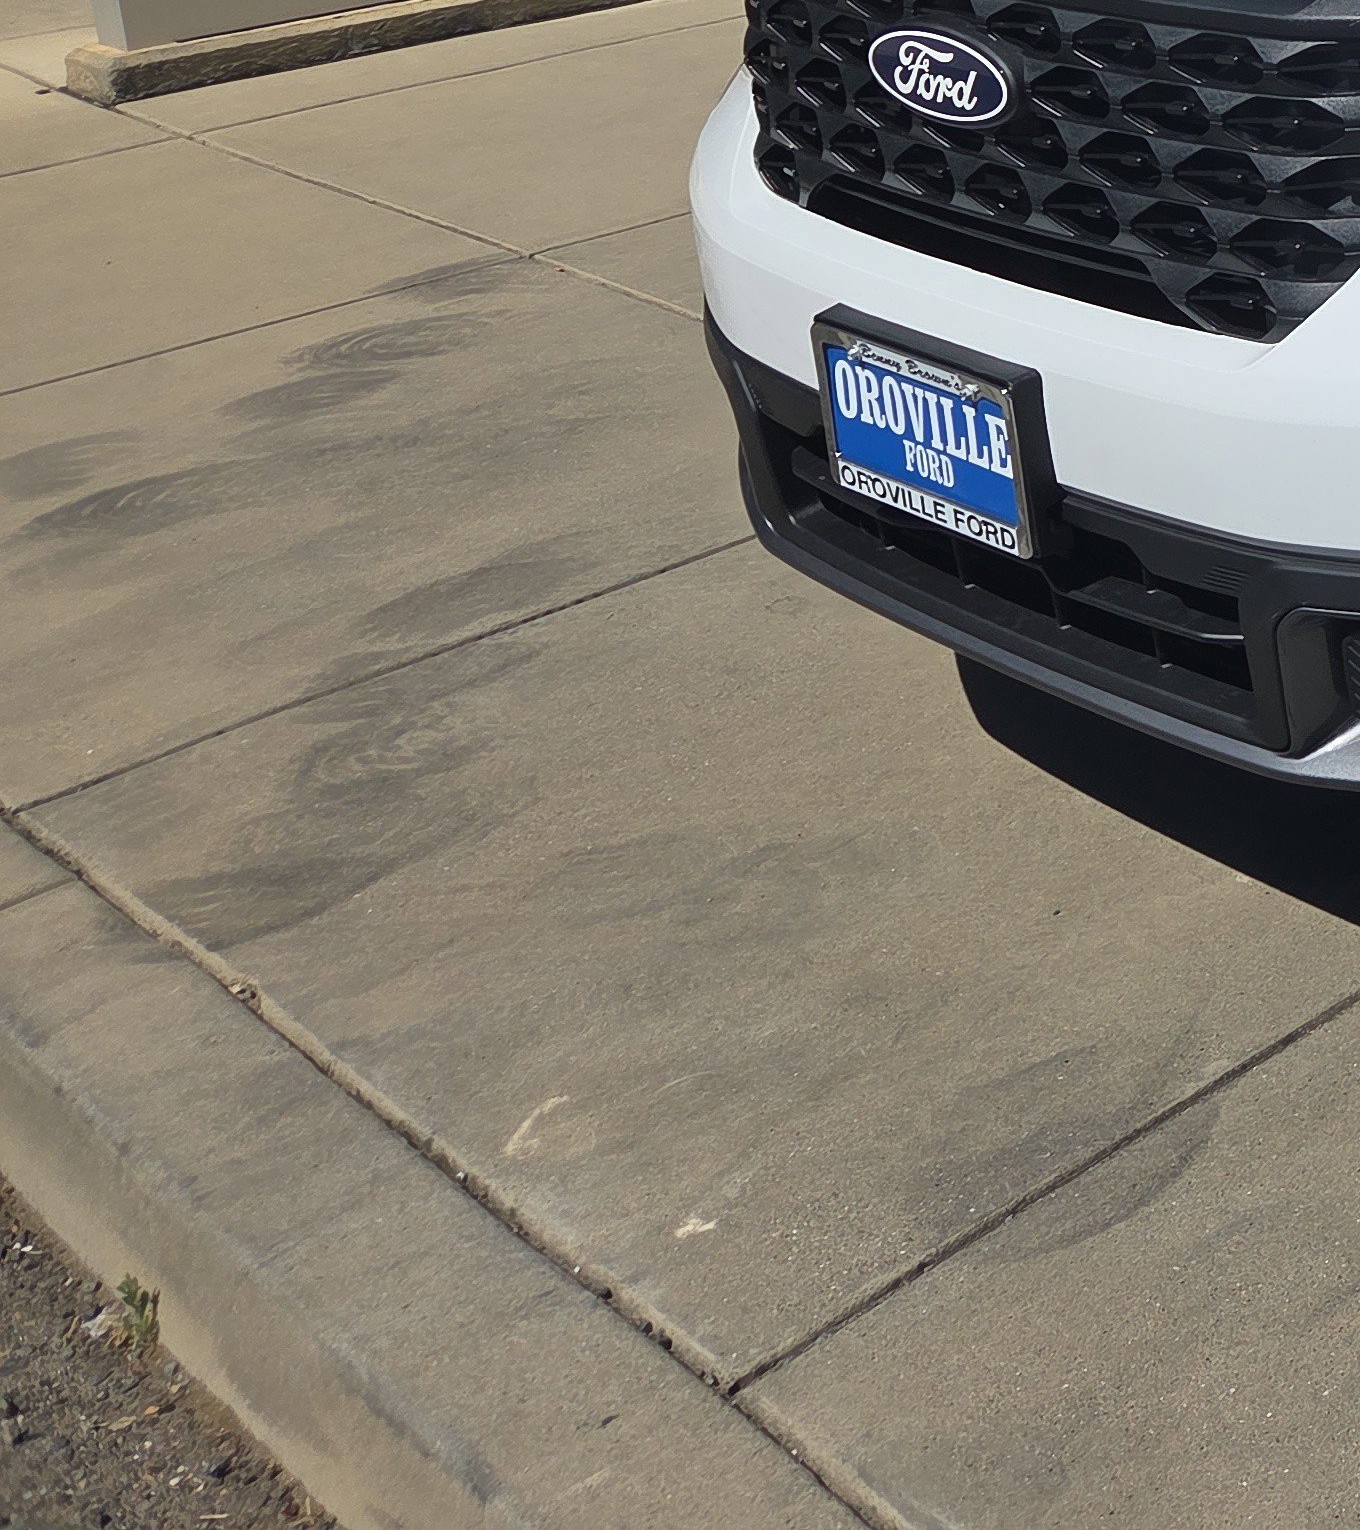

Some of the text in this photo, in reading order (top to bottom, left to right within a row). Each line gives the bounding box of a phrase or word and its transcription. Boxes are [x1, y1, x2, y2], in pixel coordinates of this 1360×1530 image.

[894, 40, 978, 111] Ford
[834, 359, 1014, 480] OROVILLE
[903, 439, 955, 488] FORD
[841, 465, 1016, 550] OROVILLE FORD
